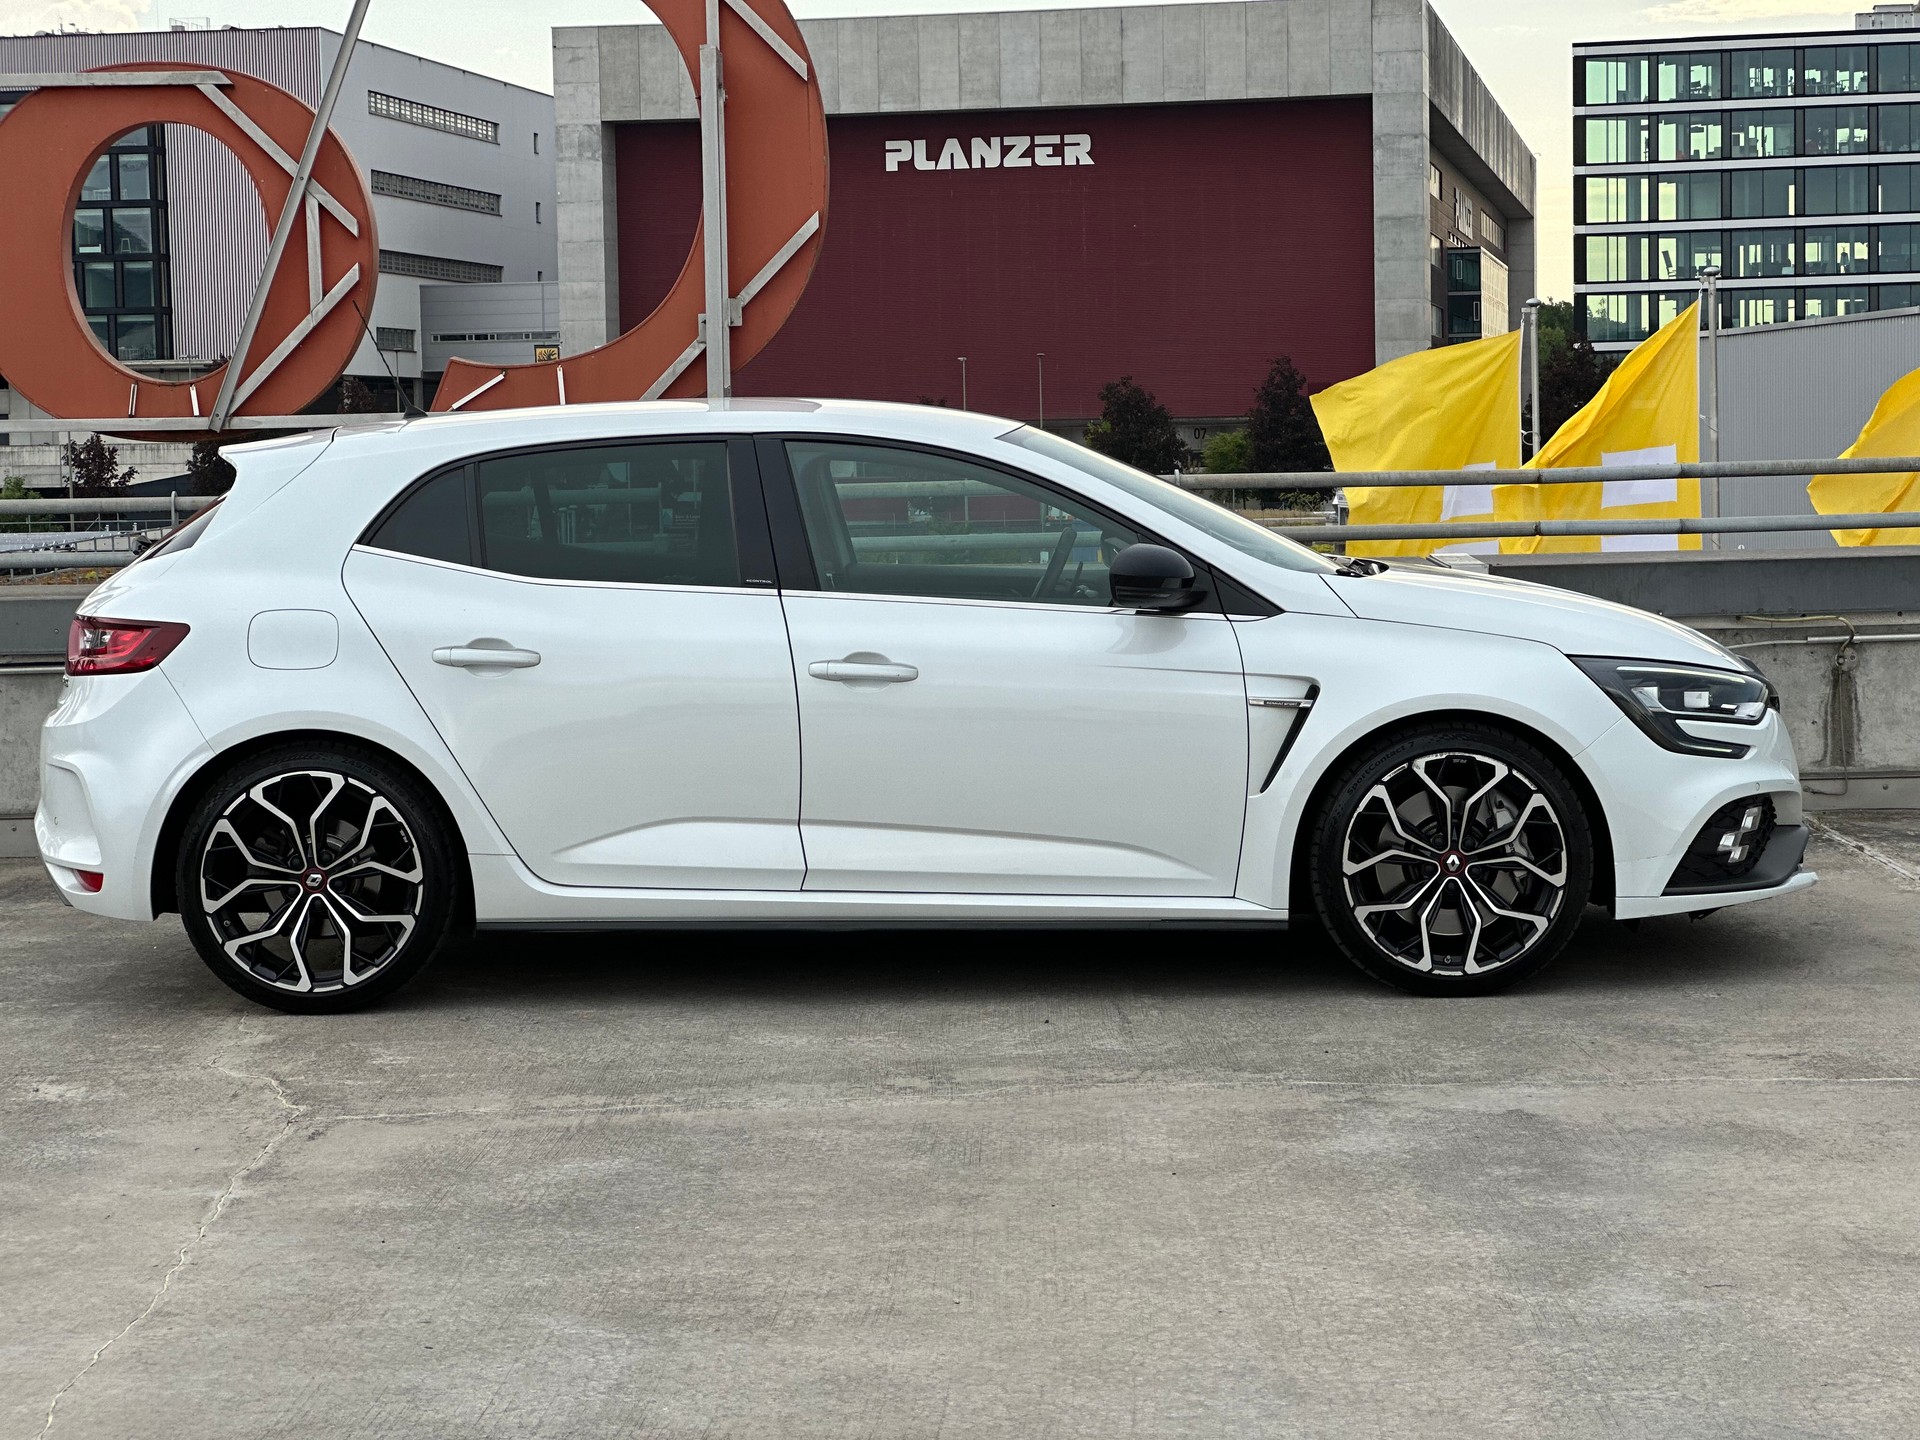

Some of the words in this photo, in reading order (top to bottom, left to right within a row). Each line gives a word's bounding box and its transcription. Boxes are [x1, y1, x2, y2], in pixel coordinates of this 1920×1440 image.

[885, 134, 1095, 172] PLANZER
[1193, 428, 1207, 440] 07
[1347, 745, 1405, 794] SportContact
